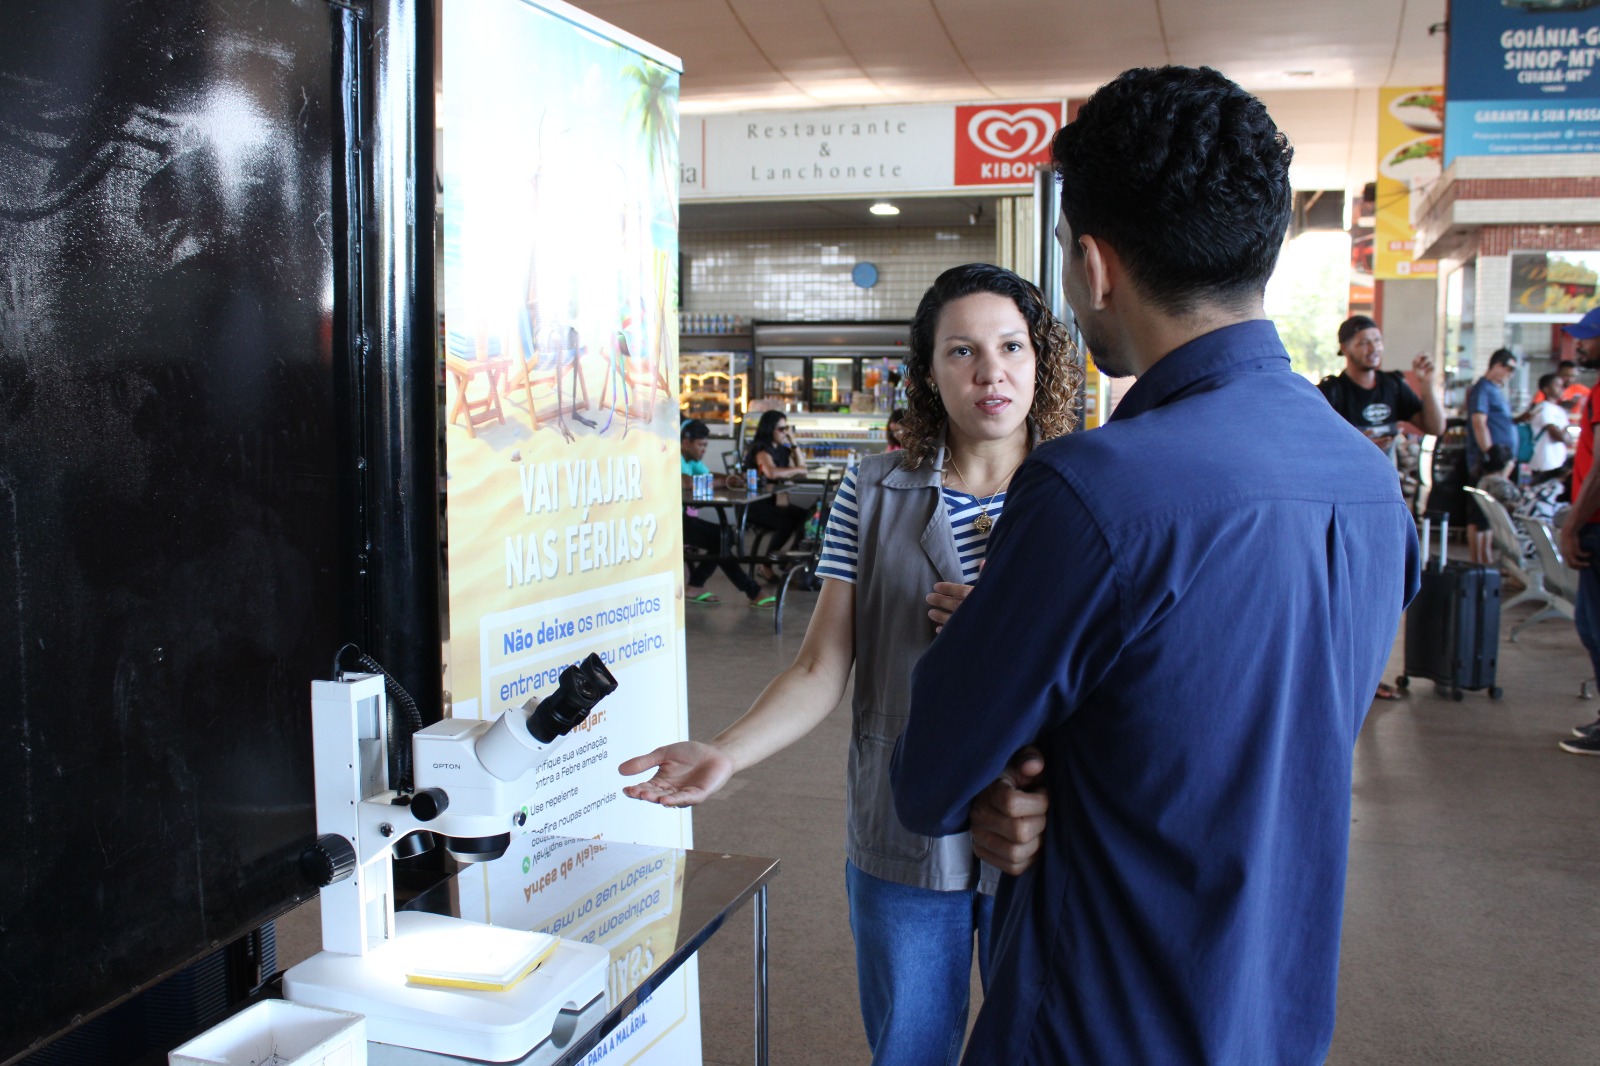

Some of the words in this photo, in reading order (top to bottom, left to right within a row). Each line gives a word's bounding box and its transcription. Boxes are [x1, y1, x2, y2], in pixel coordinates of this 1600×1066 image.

[1500, 26, 1600, 49] GOIÂNIA-G
[748, 119, 907, 138] Restaurante
[1531, 109, 1540, 122] A
[1541, 109, 1566, 122] SUA
[819, 142, 830, 157] &
[751, 164, 902, 181] Lanchonete
[519, 462, 559, 515] VAI
[565, 455, 643, 508] VIAJAR
[504, 528, 559, 588] NAS
[565, 509, 657, 575] FÉRIAS?
[504, 630, 533, 655] Não
[537, 618, 575, 646] deixe
[578, 615, 593, 634] os
[596, 596, 661, 628] mosquitos
[600, 649, 615, 665] eu
[618, 634, 665, 669] roteiro.
[535, 756, 561, 774] rifique
[563, 750, 575, 762] sua
[576, 736, 607, 757] vacinação
[535, 774, 554, 790] ntra
[556, 771, 560, 781] a
[561, 761, 581, 779] Febre
[582, 750, 608, 768] amarela
[530, 802, 544, 816] Use
[545, 786, 579, 809] repelente
[532, 822, 557, 834] efira
[559, 809, 582, 828] roupas
[583, 792, 617, 814] compridas
[587, 1042, 608, 1066] PARA
[609, 1037, 614, 1052] A
[616, 1012, 648, 1046] MALÁRIA.
